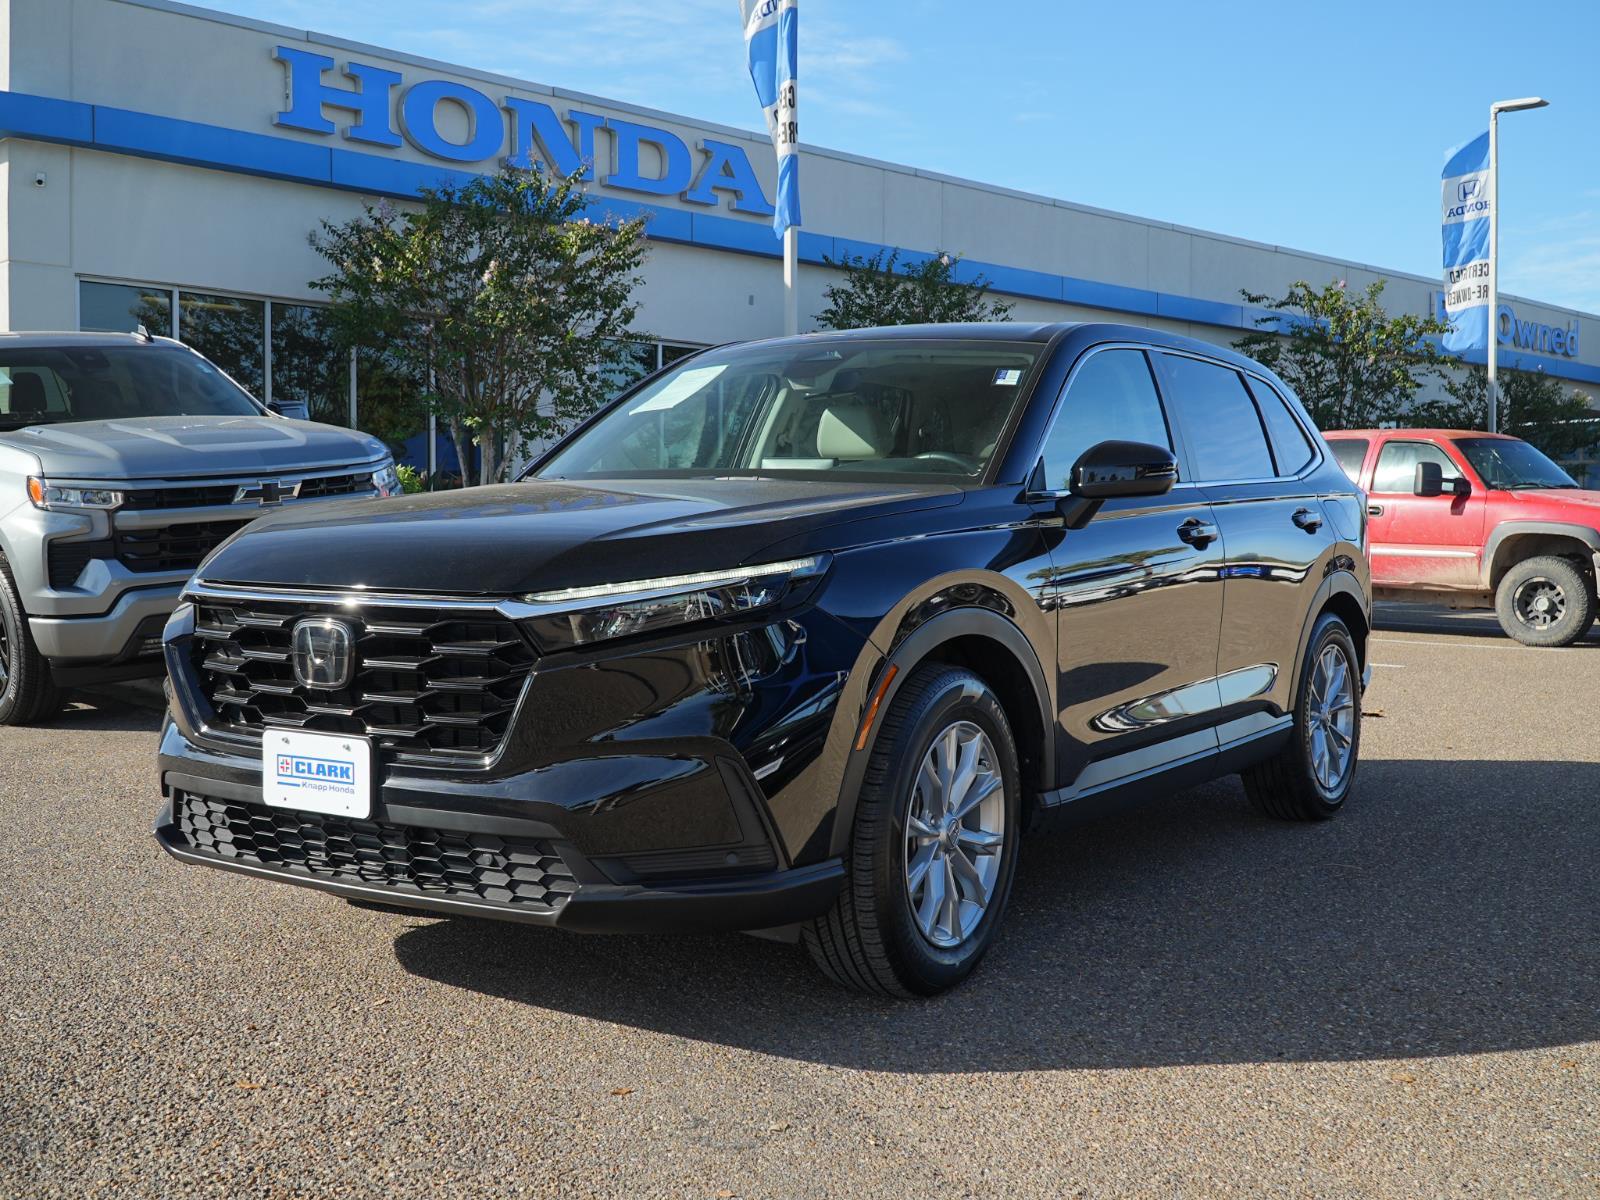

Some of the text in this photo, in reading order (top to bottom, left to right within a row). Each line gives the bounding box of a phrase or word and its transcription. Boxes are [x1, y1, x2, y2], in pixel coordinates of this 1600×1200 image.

[271, 45, 774, 216] HONDA
[1497, 303, 1579, 357] Owned
[294, 760, 351, 780] CLARK
[301, 781, 355, 795] Knapp Honda
